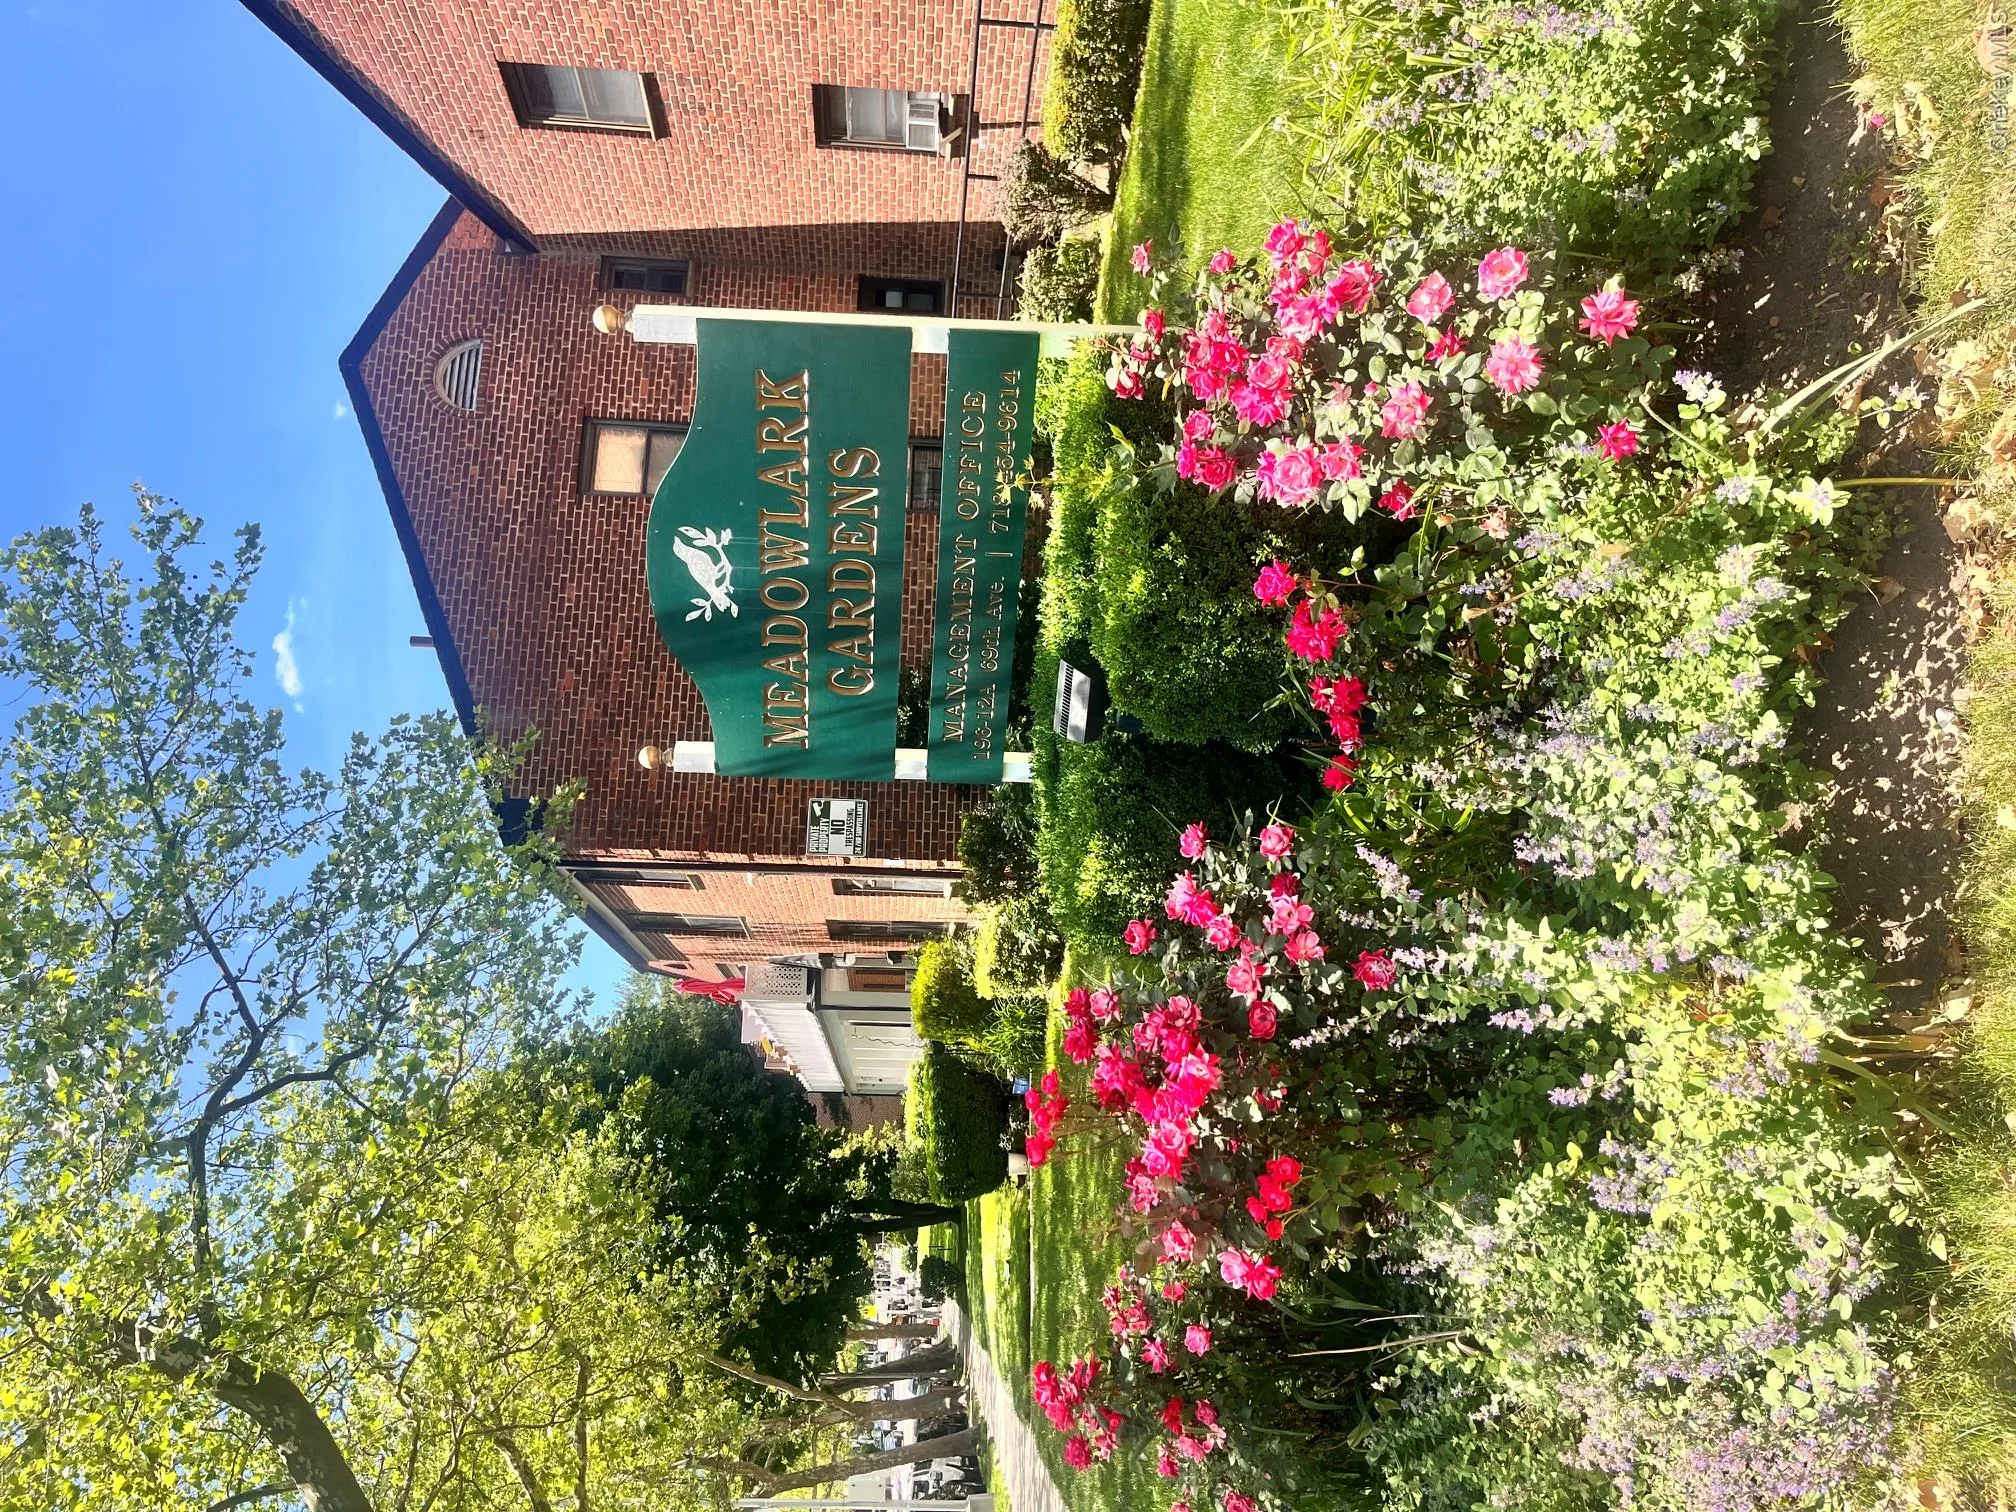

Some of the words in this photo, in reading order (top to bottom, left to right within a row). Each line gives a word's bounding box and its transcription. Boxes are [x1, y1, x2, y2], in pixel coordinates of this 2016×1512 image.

[955, 392, 986, 520] OFFICE
[988, 369, 1020, 534] 718454-9614
[755, 369, 808, 749] MEADOWLARK
[827, 446, 880, 697] GARDENS
[985, 576, 1005, 620] Ave.
[943, 534, 976, 742] MANAGEMENT
[979, 626, 1001, 672] 69th
[973, 684, 996, 760] 196-12A
[809, 825, 820, 852] PRIVATE
[819, 817, 829, 852] PROPERTY
[830, 819, 845, 835] NO
[845, 808, 854, 847] TRESPASSING
[855, 802, 863, 837] SURVEILLANCE
